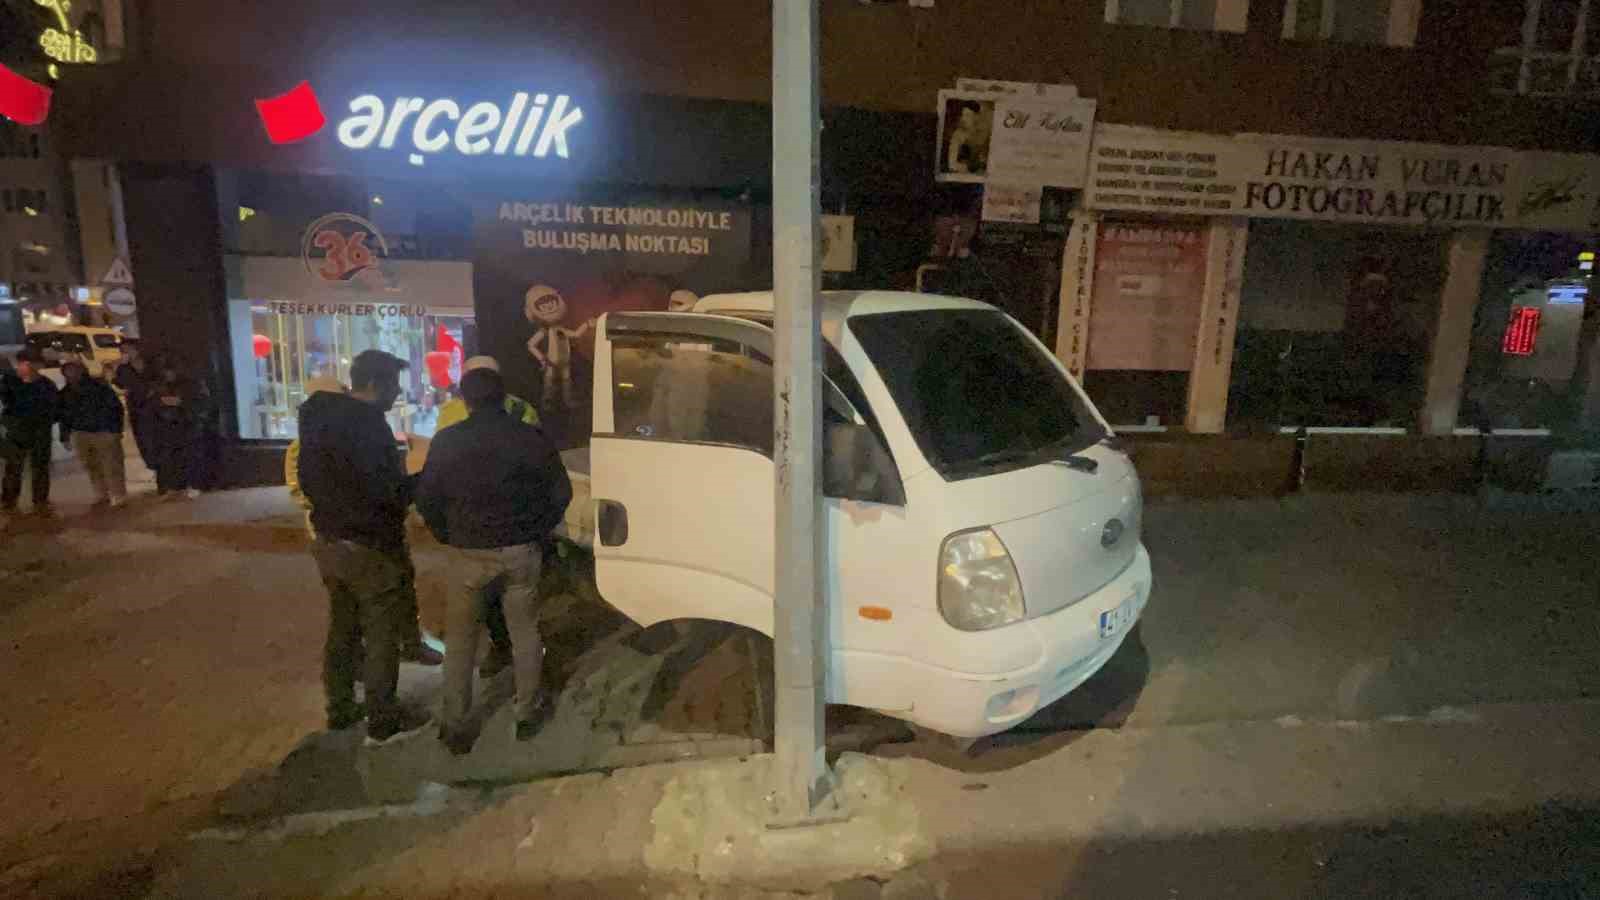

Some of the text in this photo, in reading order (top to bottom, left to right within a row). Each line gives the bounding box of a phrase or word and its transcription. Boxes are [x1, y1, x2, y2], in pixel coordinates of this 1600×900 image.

[337, 91, 583, 166] arçelik
[1264, 150, 1508, 187] HAKAN VURAN
[499, 202, 732, 231] ARÇELİK TEKNOLOJİYLE
[523, 229, 710, 255] BULUŞMA NOKTASI
